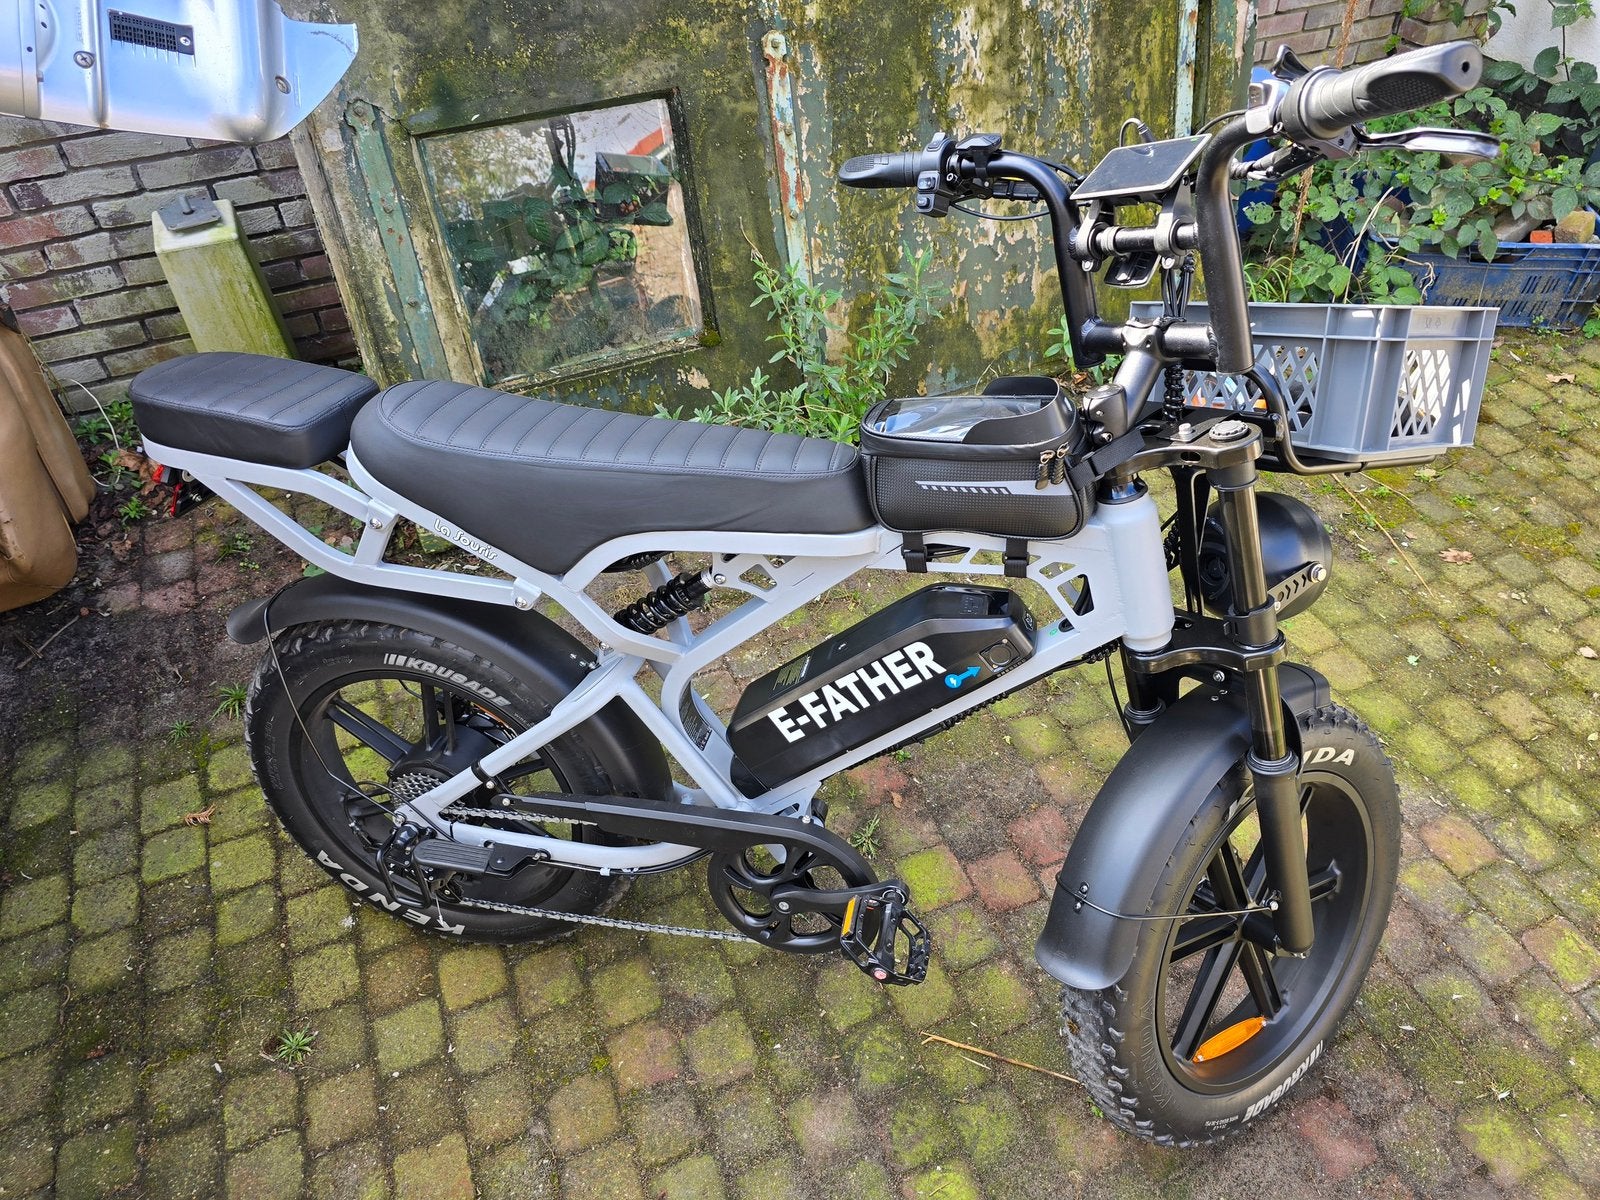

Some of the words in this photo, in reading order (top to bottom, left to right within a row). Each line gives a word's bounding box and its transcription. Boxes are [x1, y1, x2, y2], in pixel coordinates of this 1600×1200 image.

[453, 529, 498, 560] Souris
[405, 657, 511, 707] KRUSADE
[767, 641, 946, 743] E-FATHER
[316, 849, 466, 935] KENDA
